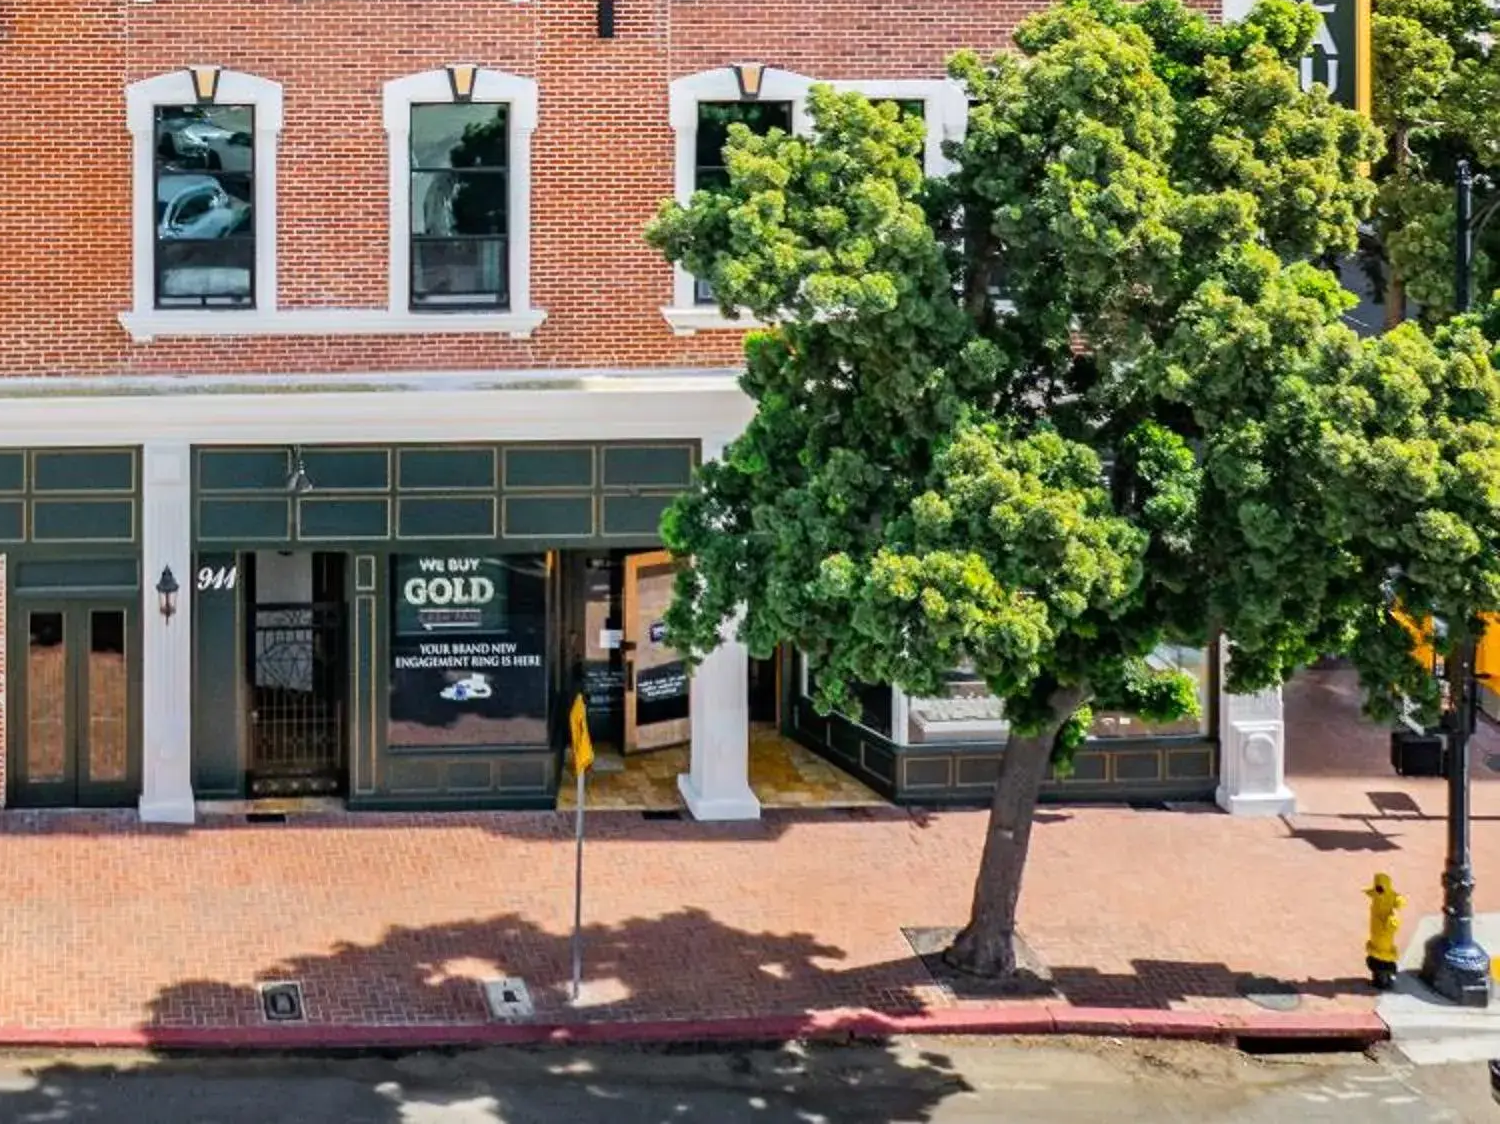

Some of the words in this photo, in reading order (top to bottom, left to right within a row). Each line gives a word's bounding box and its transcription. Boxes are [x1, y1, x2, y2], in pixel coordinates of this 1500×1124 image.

[419, 558, 445, 572] WE
[447, 558, 480, 572] BUY
[197, 566, 237, 591] 911
[404, 577, 495, 604] GOLD
[420, 643, 451, 655] YOUR
[452, 643, 490, 654] BRAND
[491, 642, 517, 653] NEW
[395, 656, 470, 669] ENGAGEMENT
[471, 656, 500, 667] RING
[501, 656, 512, 667] IS
[513, 654, 541, 667] HERE
